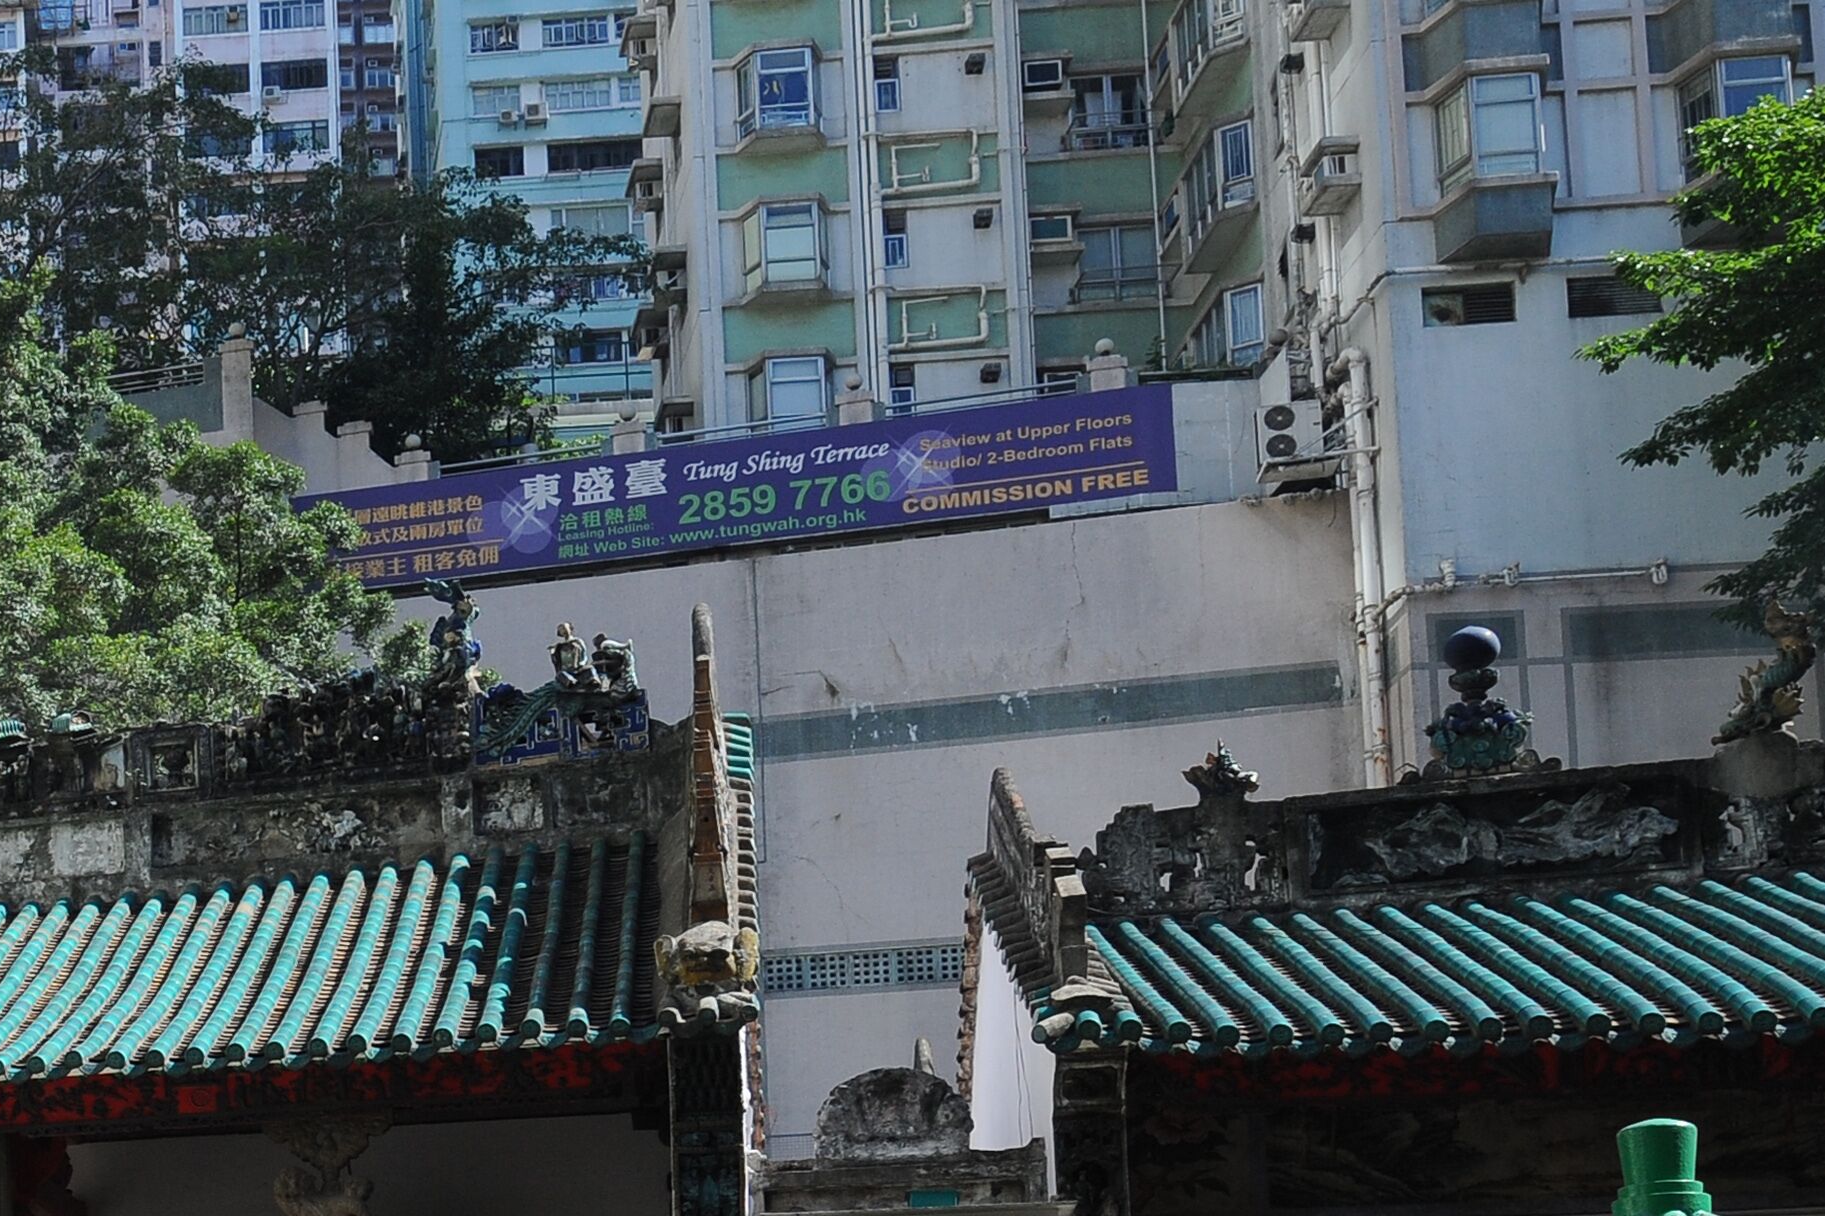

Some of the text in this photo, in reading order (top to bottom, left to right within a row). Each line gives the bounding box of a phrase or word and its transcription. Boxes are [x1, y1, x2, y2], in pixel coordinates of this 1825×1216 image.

[920, 413, 1132, 452] Seaview at Upper Floors
[987, 442, 1084, 465] 2-Bedroom
[1090, 434, 1133, 452] Flats
[683, 441, 890, 483] Tung Shing Terrace
[520, 458, 668, 512] 東盛臺
[678, 470, 891, 525] 2859 7766
[902, 469, 1150, 514] COMMISSION FREE
[558, 522, 654, 541] Leasing Hotline:
[559, 508, 866, 558] 網址 Web Site: www.tungwah.org.hk
[560, 504, 647, 531] 洽租熱線
